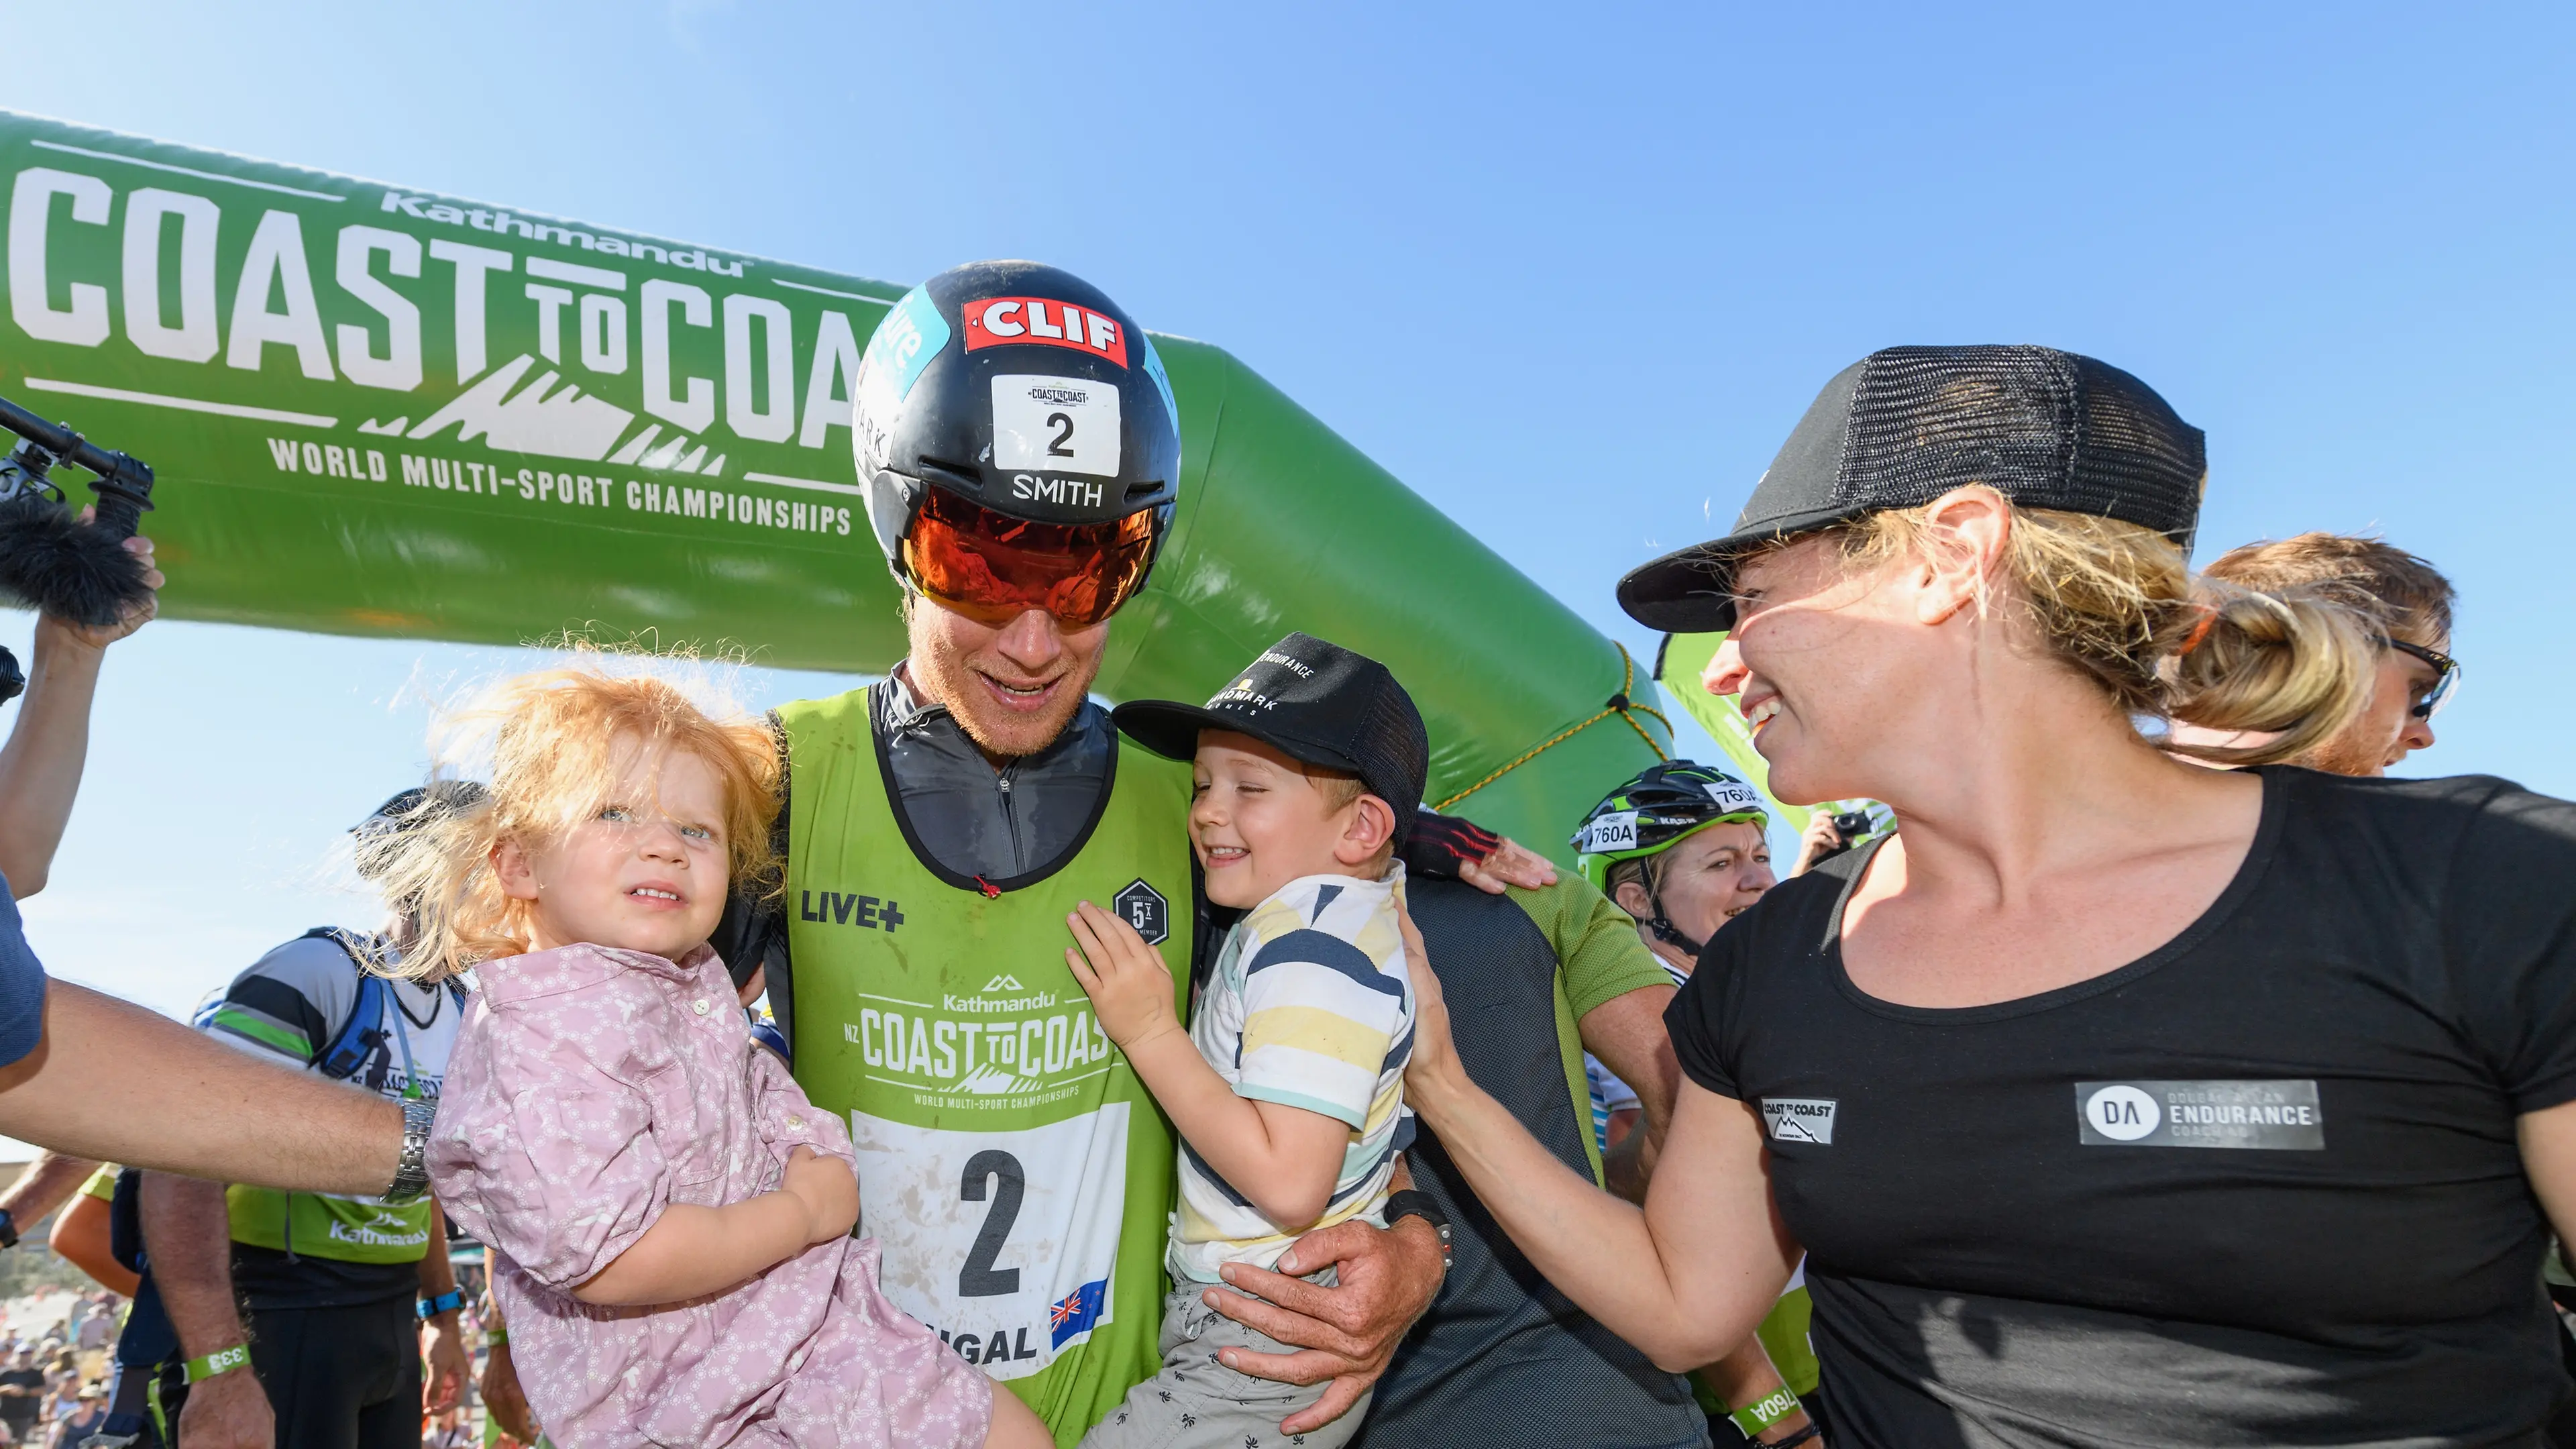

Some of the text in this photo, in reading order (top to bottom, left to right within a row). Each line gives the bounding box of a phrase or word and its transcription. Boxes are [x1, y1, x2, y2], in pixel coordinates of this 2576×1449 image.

[380, 191, 743, 278] Kathmandu
[8, 166, 861, 449] COAST TO COA
[981, 301, 1116, 352] CLIF
[1032, 388, 1056, 400] COAST
[1063, 390, 1086, 403] COAST
[1047, 413, 1073, 458] 2
[267, 437, 851, 536] WORLD MULTI-SPORT CHAMPIONSHIPS
[1013, 474, 1102, 507] SMITH
[1261, 652, 1313, 679] ENDURANCE
[1595, 824, 1633, 843] 760A
[944, 991, 1055, 1013] Kathmandu
[844, 1008, 1118, 1078] NZ COAST TO COAS
[914, 1085, 1079, 1110] WORLD MULTI-SPORT CHAMPIONSHIPS
[1764, 1104, 1784, 1114] COAST
[1794, 1104, 1831, 1117] COAST
[2169, 1105, 2312, 1125] ENDURANCE
[959, 1149, 1025, 1297] 2
[1750, 1389, 1796, 1422] 760A
